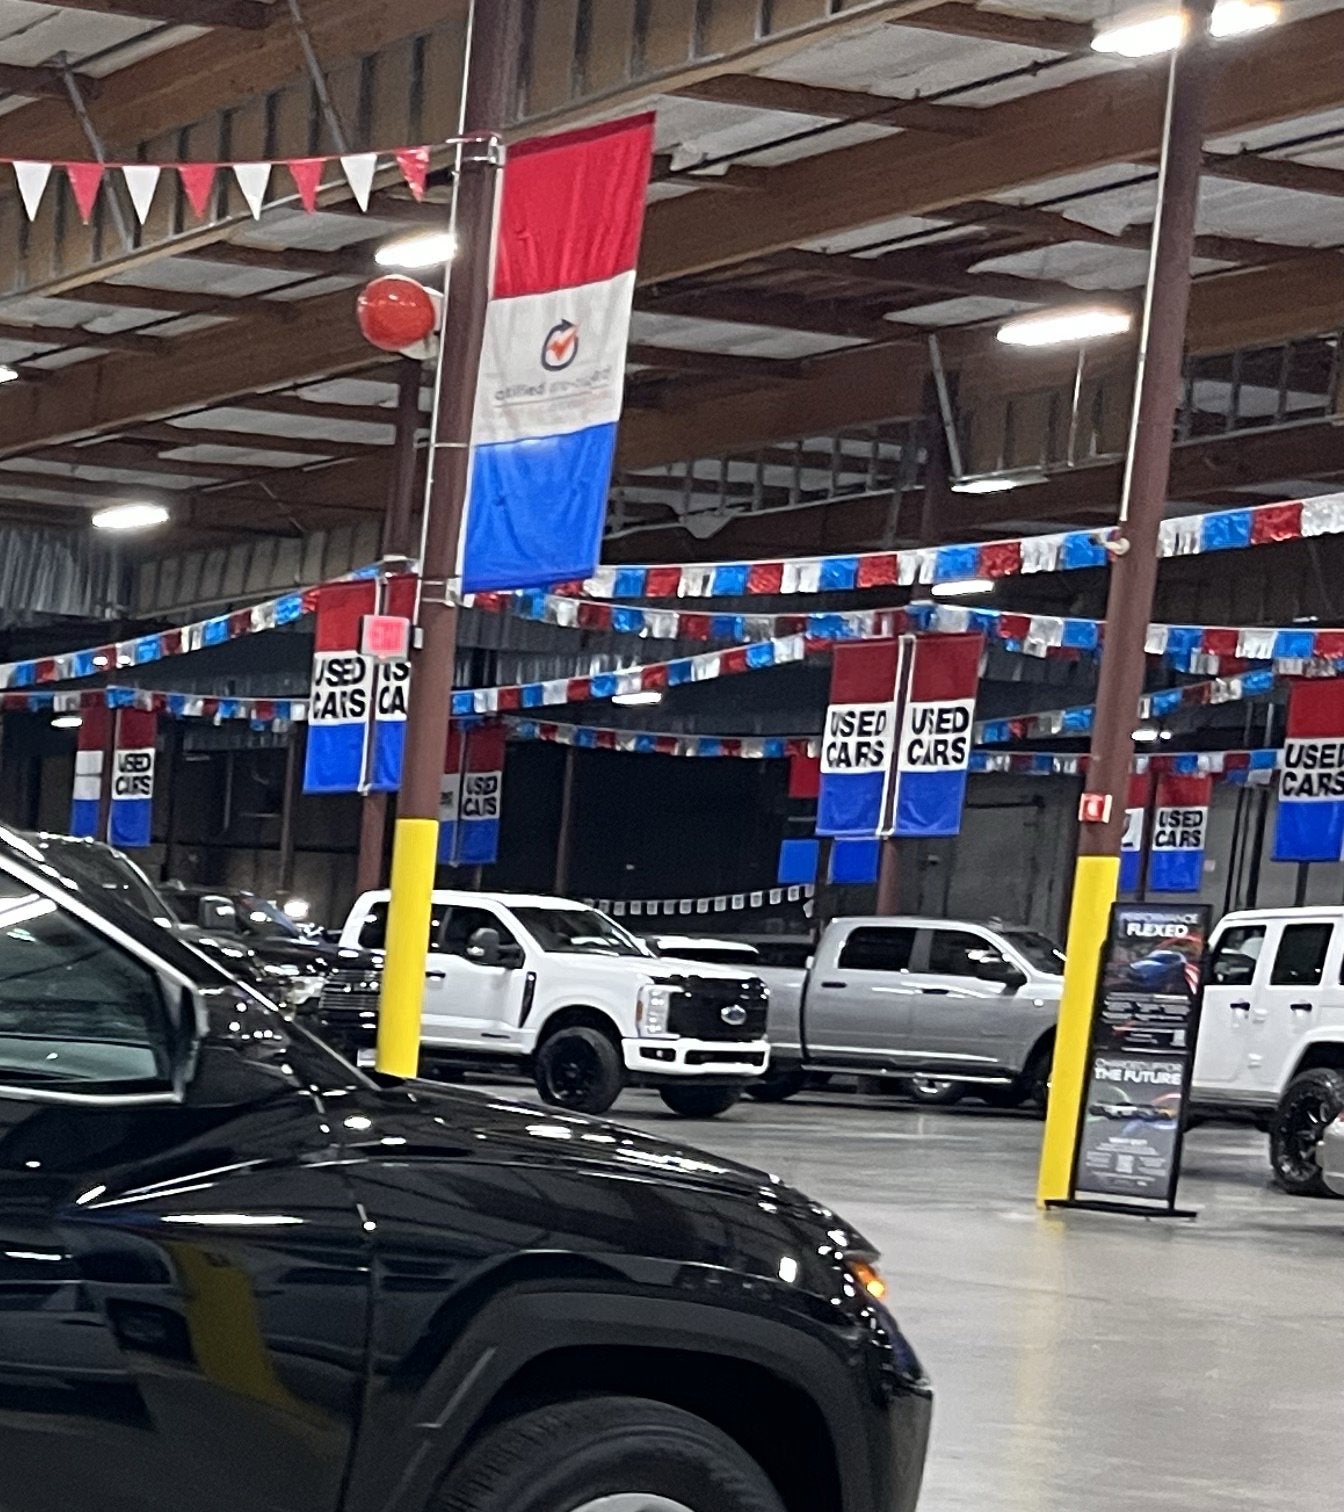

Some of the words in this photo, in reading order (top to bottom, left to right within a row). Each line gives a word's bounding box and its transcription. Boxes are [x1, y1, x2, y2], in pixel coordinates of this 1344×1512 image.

[829, 710, 887, 738] USED
[912, 706, 970, 735] USED
[826, 740, 885, 768] CARS
[907, 737, 967, 766] CARS
[117, 752, 152, 773] USED
[466, 776, 498, 796] USED
[1159, 810, 1204, 828] USED
[1155, 829, 1202, 848] CARS
[1126, 922, 1188, 938] FLEXED
[1124, 1069, 1182, 1085] FUTURE
